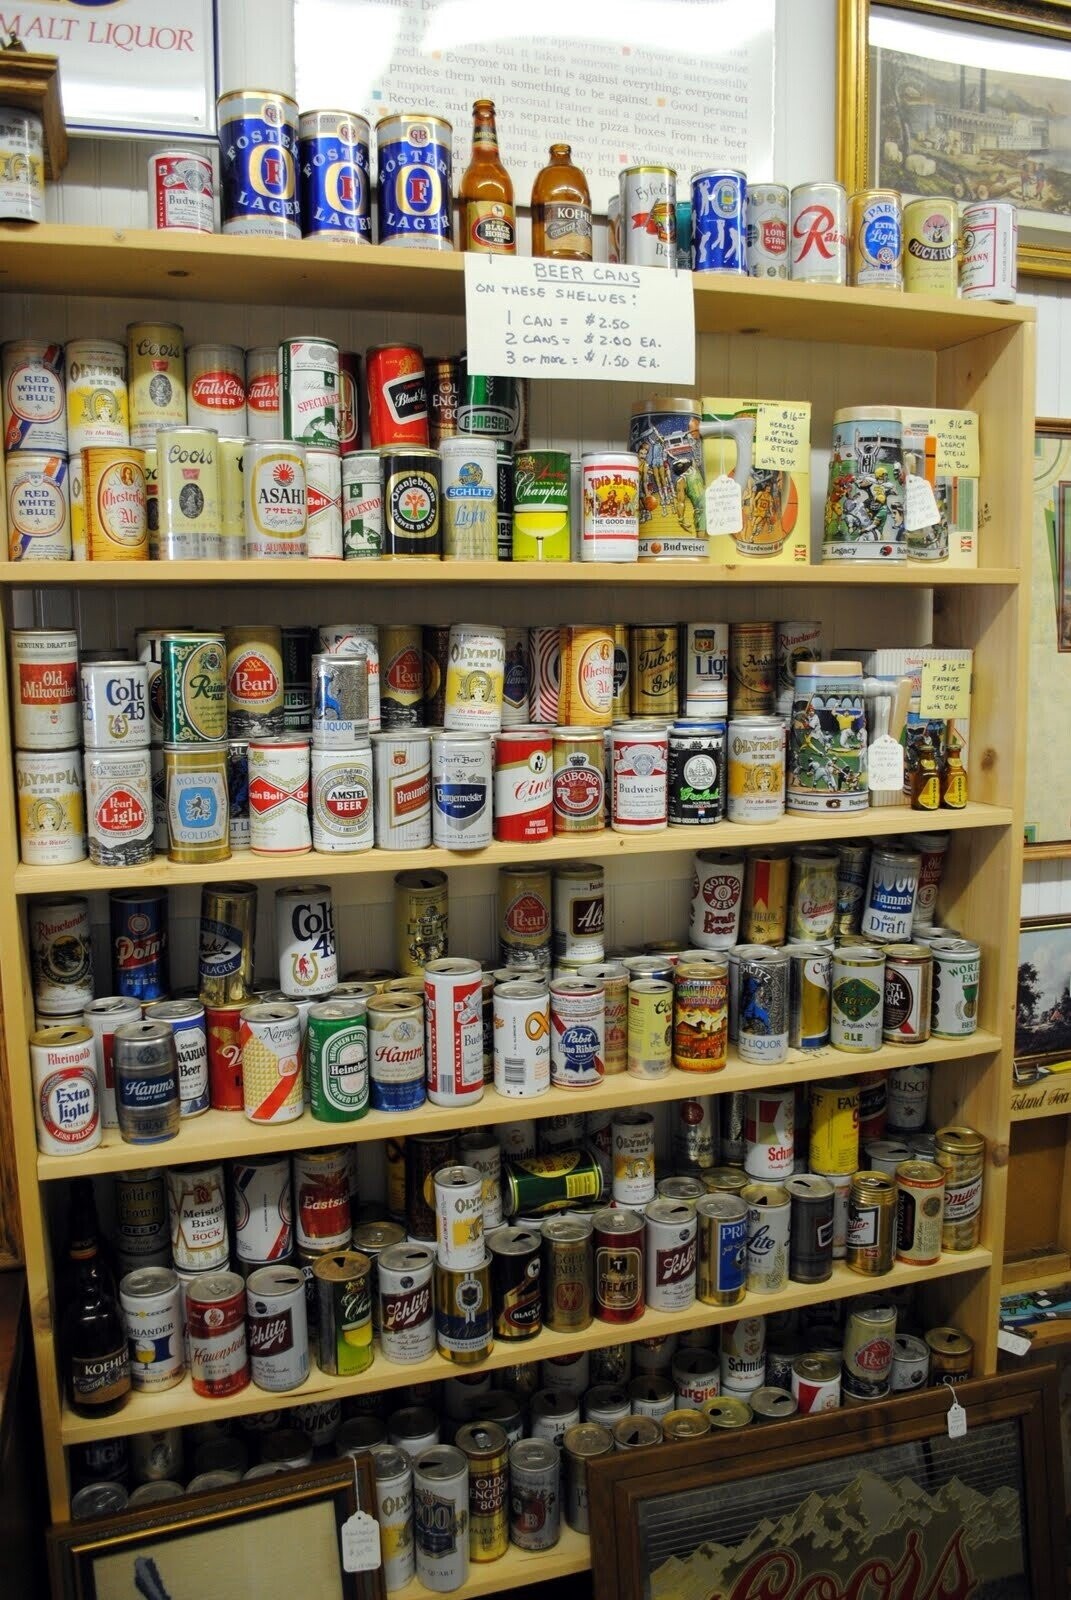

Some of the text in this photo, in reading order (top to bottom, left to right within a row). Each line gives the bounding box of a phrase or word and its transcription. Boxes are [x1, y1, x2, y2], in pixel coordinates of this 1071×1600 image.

[0, 14, 195, 52] MALT LIQUOR
[446, 52, 500, 71] Everyone
[503, 62, 518, 71] on
[522, 64, 541, 74] the
[565, 70, 575, 79] is
[578, 71, 619, 85] against
[685, 87, 732, 101] everyone
[734, 94, 748, 104] on
[389, 62, 440, 77] provides
[445, 69, 475, 82] them
[479, 73, 505, 86] with
[511, 79, 571, 96] something
[575, 87, 587, 97] to
[591, 88, 605, 99] be
[670, 99, 698, 112] Good
[703, 105, 748, 120] personal
[445, 101, 468, 113] and
[520, 111, 571, 126] separate
[576, 116, 595, 128] the
[600, 122, 629, 134] pizza
[634, 125, 666, 138] boxes
[671, 130, 697, 143] from
[702, 134, 719, 145] the
[724, 137, 747, 149] beer
[379, 149, 449, 185] FOSTER
[237, 189, 301, 215] LAGER
[386, 211, 451, 231] LAGER
[484, 222, 510, 232] BLACK
[484, 230, 511, 240] HORSE
[764, 228, 786, 237] LONE
[764, 236, 786, 246] STAR
[532, 262, 641, 285] BEER CANS
[474, 283, 496, 295] ON
[501, 286, 546, 300] THESE
[506, 309, 520, 327] 1
[522, 316, 553, 328] CAN
[506, 331, 518, 346] 2
[522, 333, 560, 347] CANS
[639, 336, 663, 348] EA.
[136, 337, 181, 360] Coors
[506, 350, 518, 366] 3
[522, 356, 537, 366] or
[539, 354, 569, 367] more
[637, 356, 661, 369] EA.
[22, 373, 50, 385] RED
[89, 378, 117, 388] BEER
[16, 384, 56, 395] WHITE
[26, 393, 56, 404] BLUE
[206, 397, 236, 407] BEER
[394, 391, 416, 409] Black
[768, 421, 796, 431] HEROES
[763, 438, 801, 447] HARDWOOD
[770, 446, 794, 454] STEIN
[939, 441, 966, 451] LEGACY
[168, 444, 214, 466] Coors
[760, 457, 777, 466] with
[943, 450, 966, 459] STEIN
[936, 461, 954, 470] with
[23, 489, 50, 500] RED
[390, 476, 439, 505] Oranjeboom
[447, 486, 494, 499] SCHLITZ
[515, 472, 569, 506] Champale
[17, 499, 56, 508] WHITE
[257, 487, 306, 508] ASAHI
[306, 496, 329, 507] Belt
[26, 508, 56, 518] BLUE
[118, 507, 141, 525] Ale
[454, 504, 488, 527] Light
[605, 518, 625, 526] GOOD
[662, 542, 707, 554] Budweiser
[831, 545, 858, 557] Legacy
[16, 640, 68, 649] GENUINE DRAFT
[42, 670, 63, 688] Old
[234, 671, 274, 694] Pearl
[931, 675, 961, 684] FAVORITE
[105, 677, 147, 703] Colt
[595, 680, 613, 697] Ale
[931, 683, 961, 693] PASTIME
[934, 694, 956, 702] STEIN
[121, 701, 147, 721] 45
[323, 721, 353, 733] LIQUOR
[175, 775, 219, 788] MOLSON
[557, 770, 600, 786] TUBORG
[30, 787, 61, 796] BEER
[329, 788, 367, 801] AMSTEL
[618, 782, 667, 796] Budweiser
[109, 796, 133, 809] Pearl
[335, 800, 363, 812] BEER
[792, 796, 819, 810] Pastime
[101, 807, 144, 826] Light
[179, 830, 220, 842] GOLDEN
[703, 876, 741, 897] IRON CITY
[708, 896, 735, 911] BEER
[512, 907, 546, 926] Pearl
[703, 911, 736, 925] Draft
[702, 921, 736, 936] Beer
[870, 915, 907, 935] Draft
[125, 976, 157, 986] BEER
[567, 1029, 592, 1045] Pabst
[748, 1038, 783, 1050] LIQUOR
[558, 1042, 576, 1055] Blue
[46, 1050, 91, 1067] Rheingold
[455, 1030, 463, 1084] GENUINE
[179, 1063, 202, 1078] Beer
[124, 1080, 176, 1098] Hamm's
[889, 1078, 930, 1093] BUSCH
[54, 1086, 91, 1105] Extra
[1011, 1089, 1070, 1112] Island Tea
[57, 1104, 91, 1126] Light
[52, 1122, 96, 1143] LESS FILLING
[946, 1182, 982, 1203] Miller
[183, 1201, 225, 1220] Meister
[120, 1223, 160, 1236] BEER
[190, 1215, 220, 1230] Bräu
[191, 1227, 222, 1242] BOCK
[744, 1227, 775, 1256] Lite
[599, 1279, 637, 1293] TECATE
[386, 1286, 431, 1325] Schlitz
[249, 1318, 289, 1347] Schlitz
